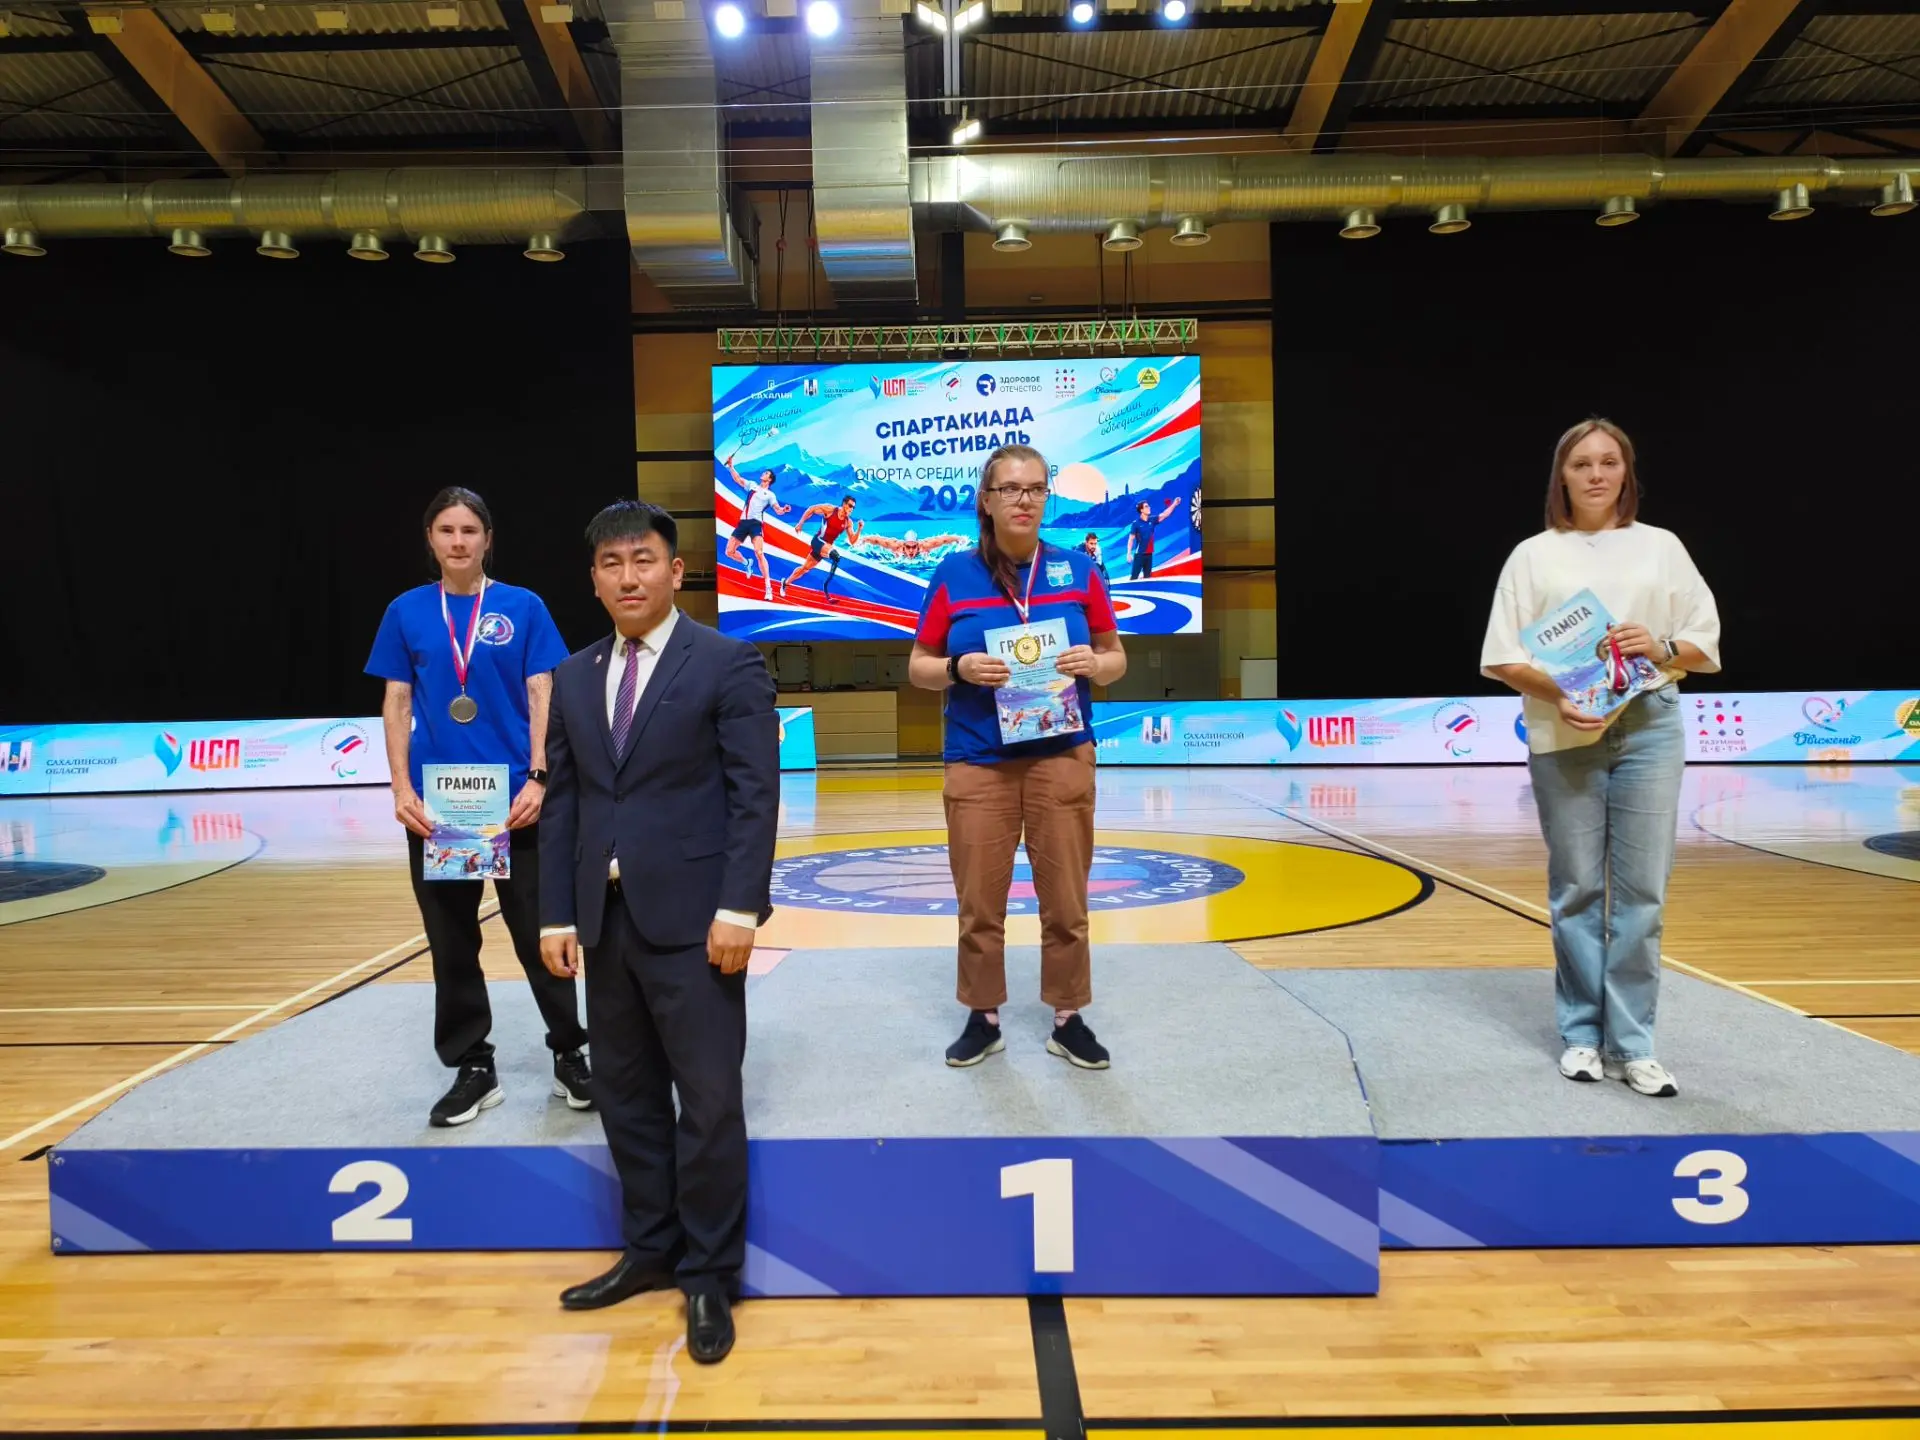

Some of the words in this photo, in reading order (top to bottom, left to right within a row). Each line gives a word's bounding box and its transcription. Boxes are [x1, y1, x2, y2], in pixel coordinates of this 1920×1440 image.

[883, 379, 907, 397] ЦСП
[999, 376, 1041, 384] ЗДОРОВОЕ
[999, 385, 1043, 393] ОТЕЧЕСТВО
[876, 407, 1034, 438] СПАРТАКИАДА
[1098, 402, 1142, 424] Сахалин
[882, 445, 897, 461] И
[902, 430, 1030, 461] ФЕСТИВАЛЬ
[856, 468, 912, 481] СПОРТА
[916, 467, 963, 481] СРЕДИ
[918, 484, 976, 512] 202
[1537, 606, 1593, 646] ГРАМОТА
[1183, 732, 1244, 740] САХАЛИНСКОЙ
[1308, 716, 1356, 748] ЦСП
[46, 757, 117, 767] САХАЛИНСКОЙ
[189, 739, 240, 772] ЦСП
[45, 766, 89, 775] ОБЛАСТИ
[437, 777, 496, 790] ГРАМОТА
[1671, 1150, 1749, 1224] 3
[330, 1161, 413, 1241] 2
[1000, 1159, 1074, 1273] 1
